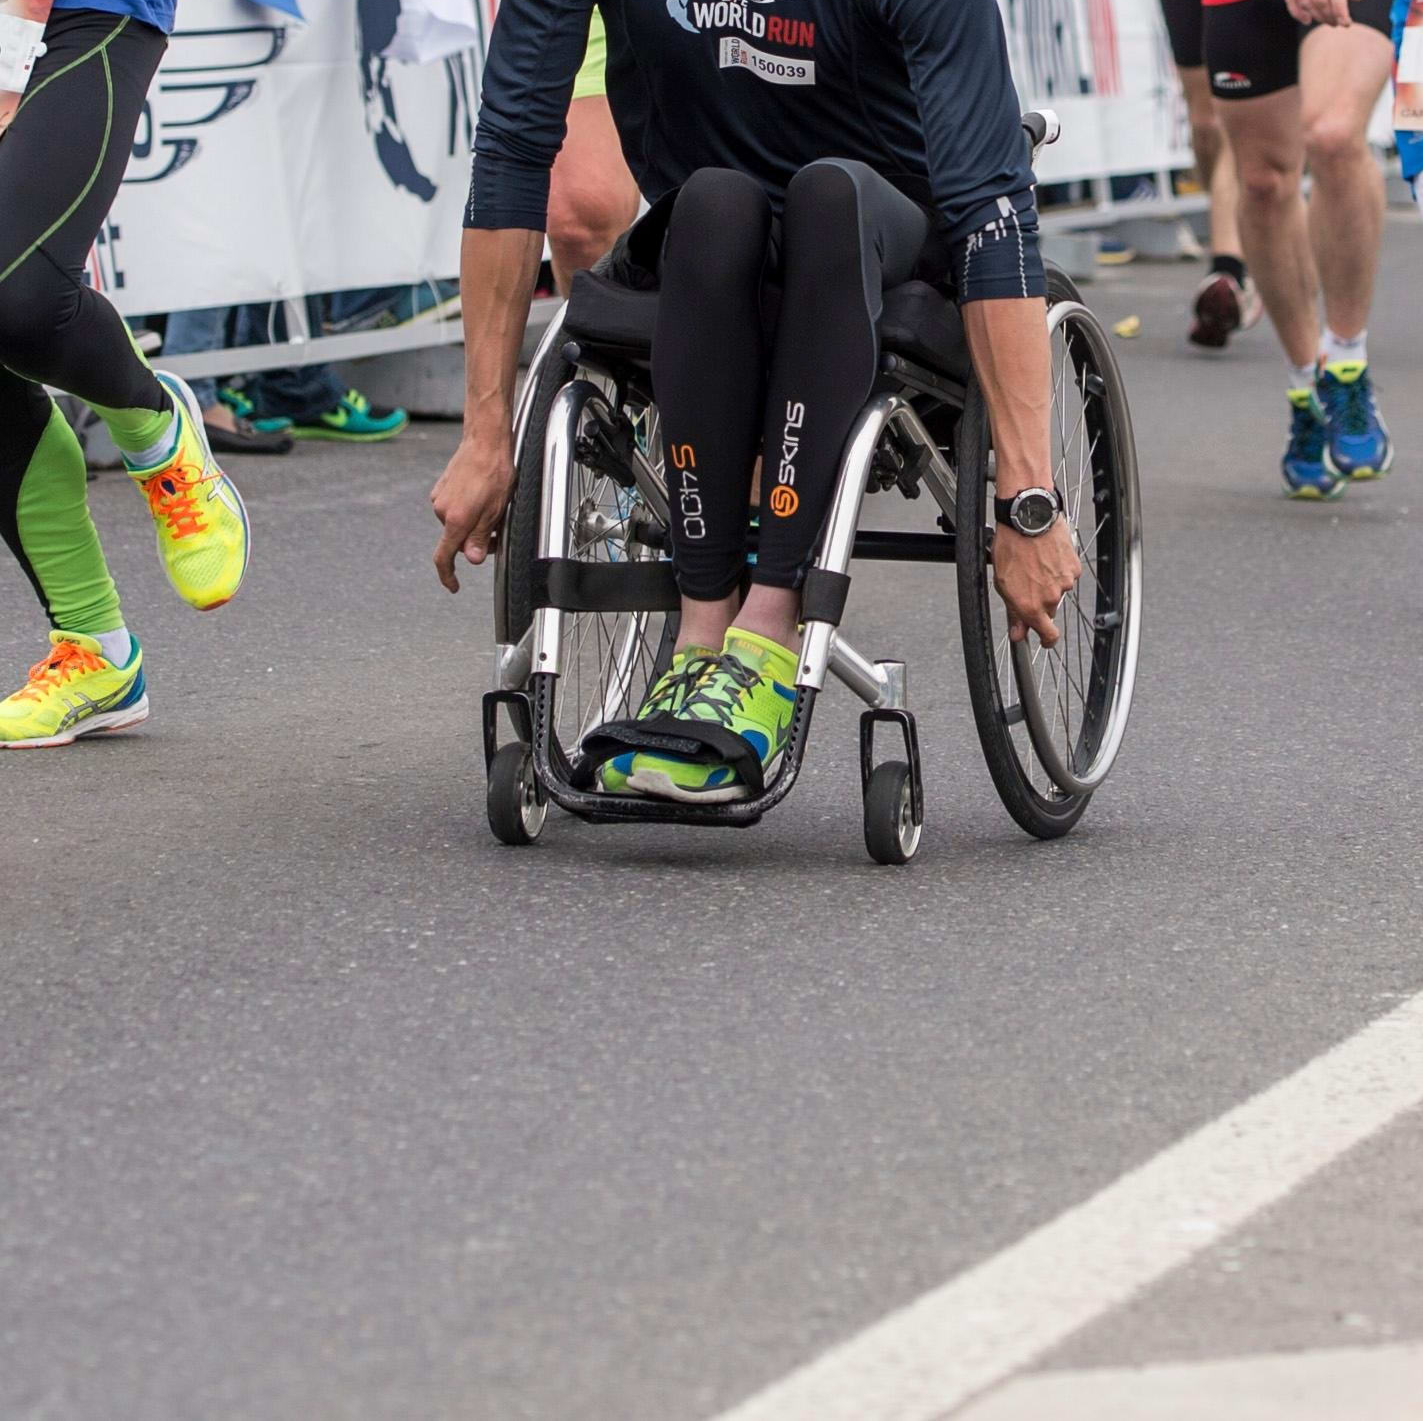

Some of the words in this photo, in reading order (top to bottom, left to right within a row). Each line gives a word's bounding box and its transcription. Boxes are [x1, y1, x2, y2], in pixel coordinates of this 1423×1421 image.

[693, 1, 766, 38] WORLD
[767, 15, 816, 48] RUN
[730, 38, 741, 65] WORLD
[751, 54, 807, 78] 150039
